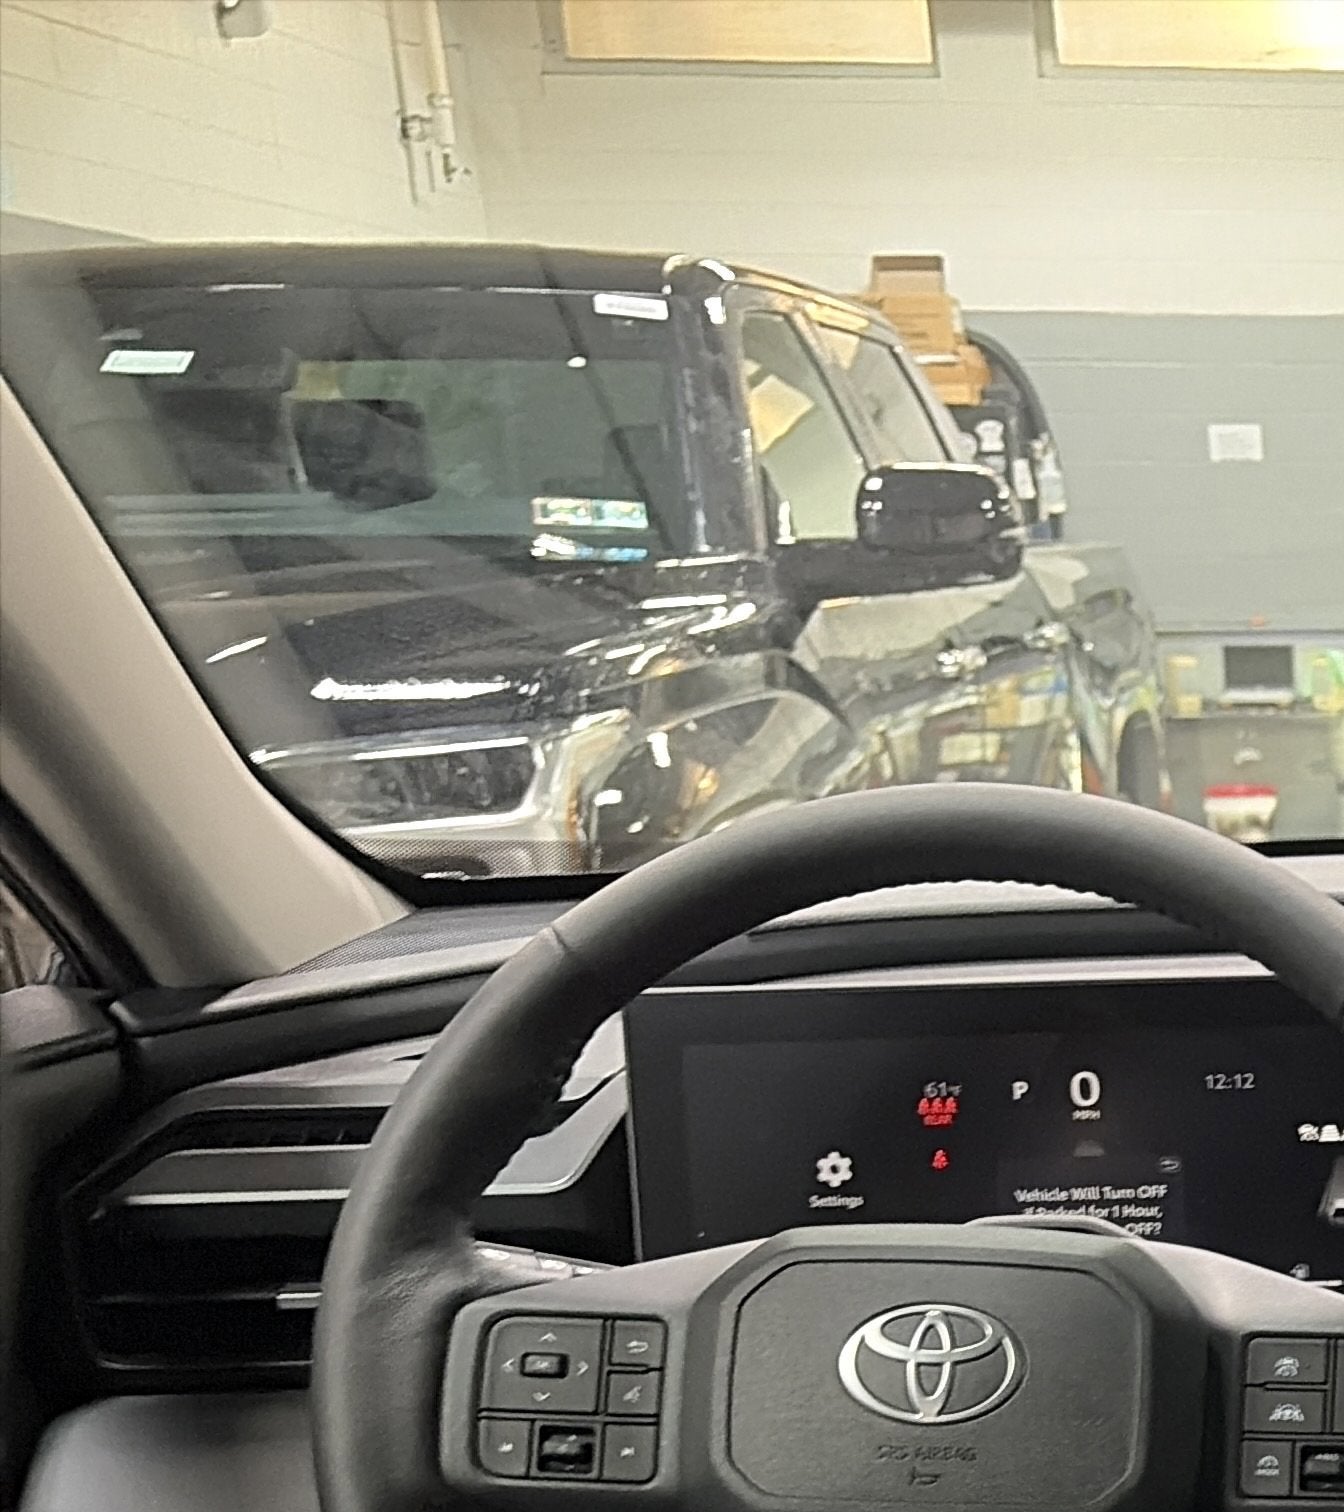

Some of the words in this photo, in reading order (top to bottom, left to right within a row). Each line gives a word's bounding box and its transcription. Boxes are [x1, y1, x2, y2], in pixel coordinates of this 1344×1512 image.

[1069, 1070, 1101, 1107] 0
[1204, 1073, 1255, 1090] 12:12
[1012, 1081, 1029, 1100] P
[808, 1194, 864, 1209] Settings
[1013, 1187, 1069, 1202] Vehicle
[1070, 1185, 1101, 1201] Will
[1101, 1185, 1136, 1200] Turn
[1136, 1184, 1168, 1199] OFF
[1088, 1204, 1110, 1218] for
[1111, 1204, 1121, 1218] 1
[1121, 1203, 1163, 1219] Hour,
[1125, 1222, 1163, 1237] OFF?
